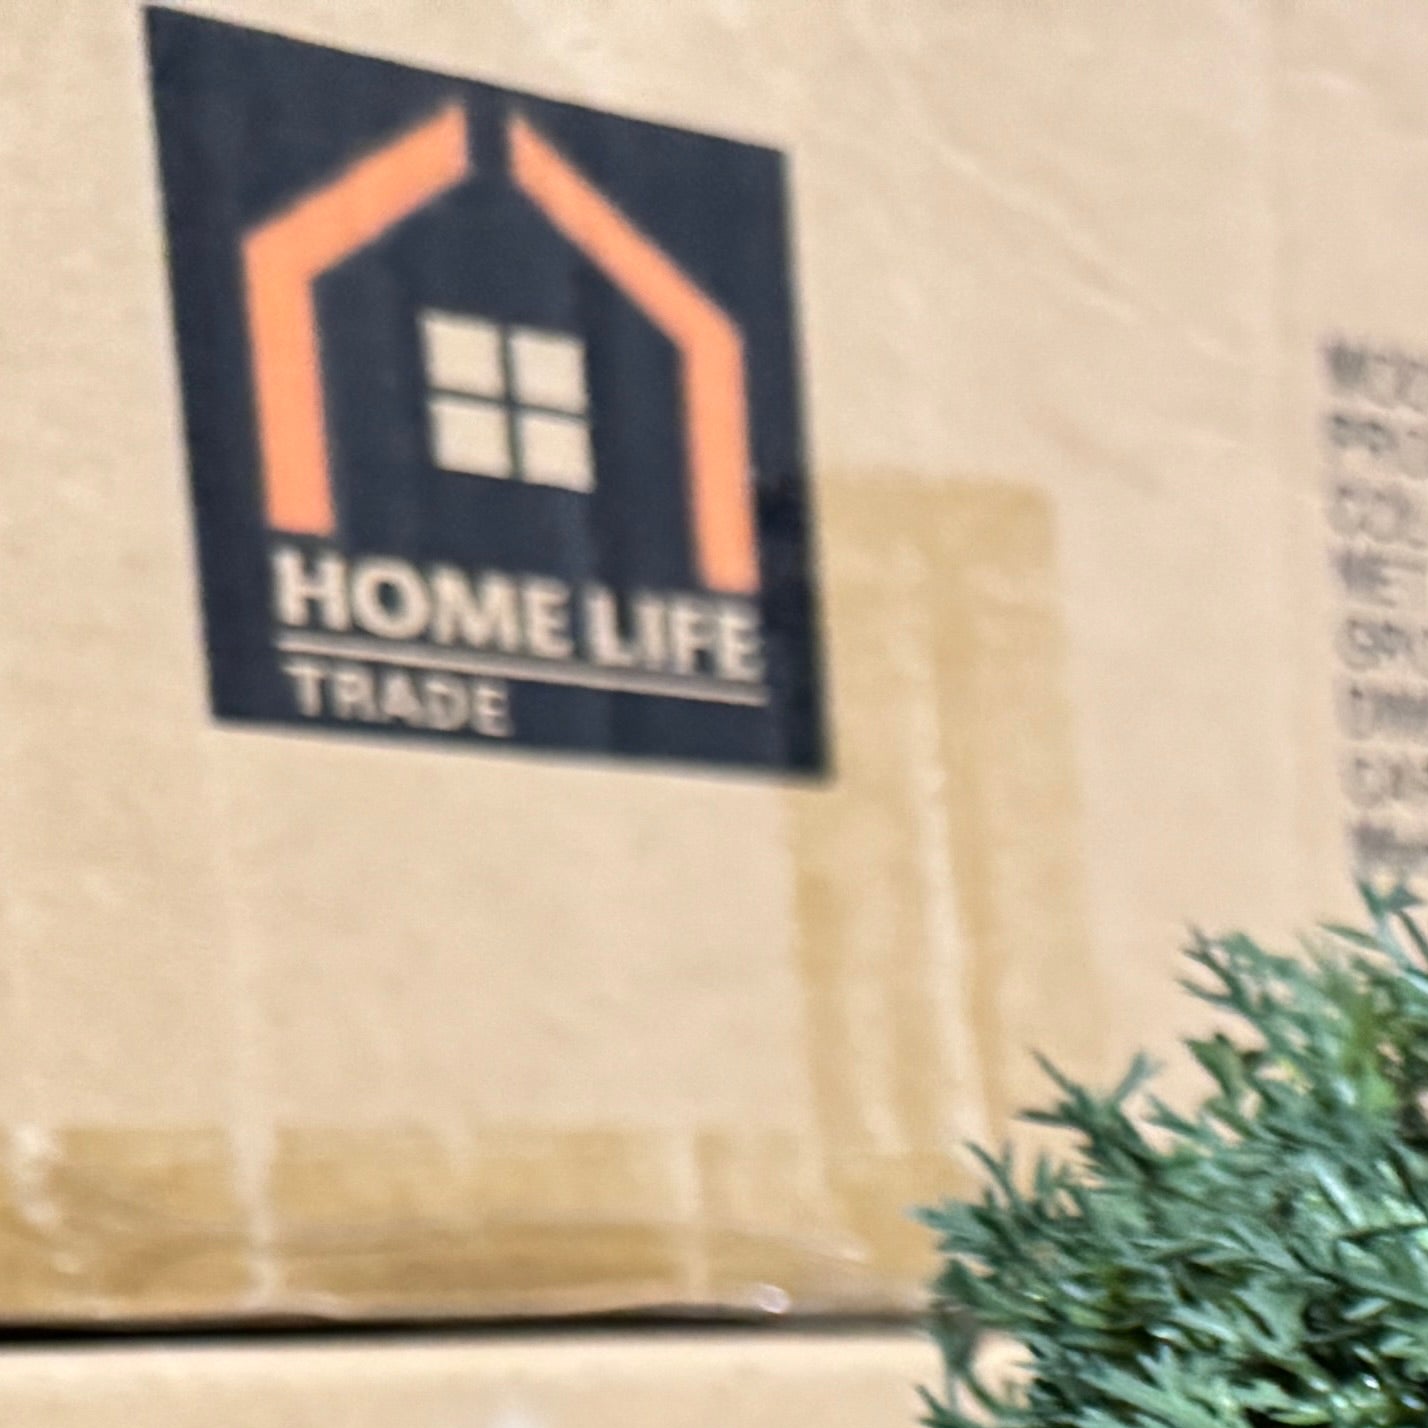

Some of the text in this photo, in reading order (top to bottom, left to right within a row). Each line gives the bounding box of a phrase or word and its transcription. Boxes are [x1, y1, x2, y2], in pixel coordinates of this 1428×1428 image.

[272, 543, 766, 683] HOME LIFE
[284, 658, 514, 739] TRADE
